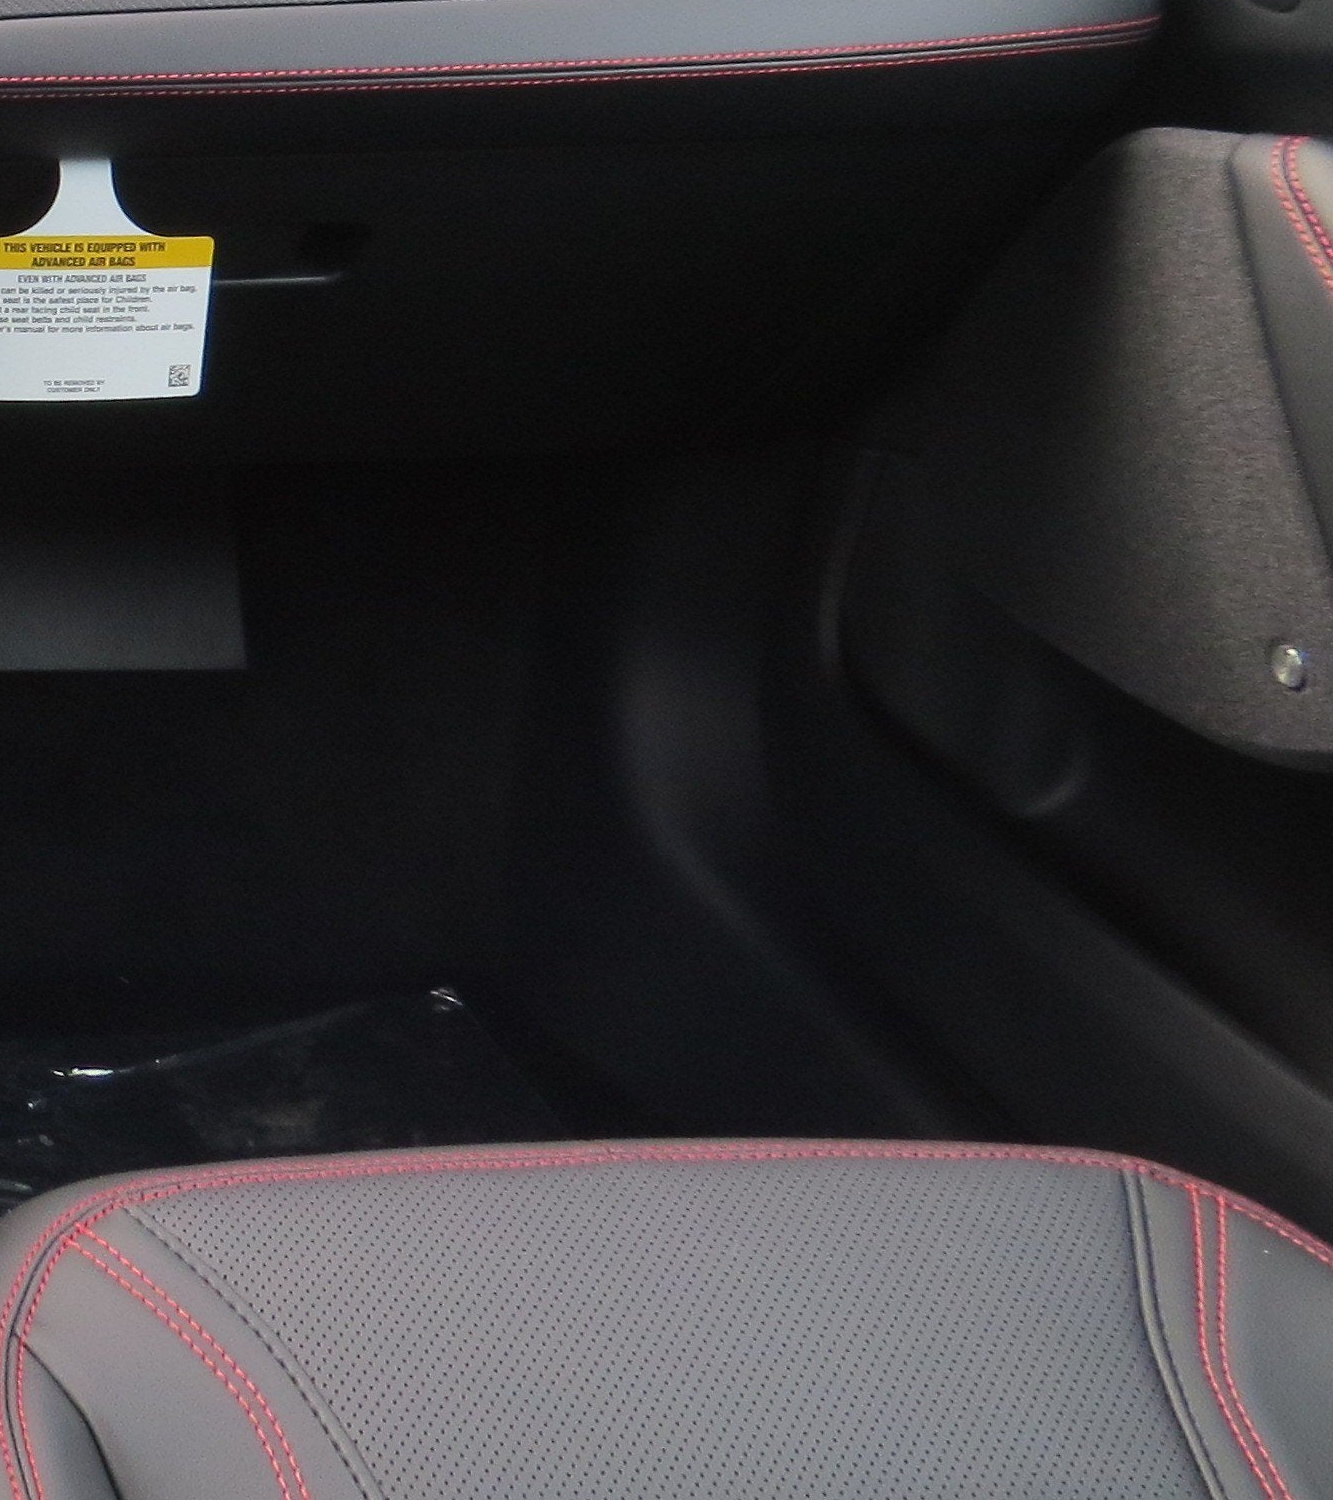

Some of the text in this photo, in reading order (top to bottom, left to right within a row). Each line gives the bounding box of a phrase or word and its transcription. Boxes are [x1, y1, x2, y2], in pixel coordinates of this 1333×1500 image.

[4, 241, 166, 253] THIS VEHICLE IS EQUIPPED WITH
[31, 256, 136, 267] ADVANCED AIR BAGS
[17, 274, 147, 283] EVEN WITH ADVANCED AIR BAGS
[0, 287, 17, 295] can
[18, 286, 29, 295] be
[31, 286, 54, 295] killed
[68, 286, 107, 296] seriously
[109, 285, 138, 295] injured
[152, 285, 165, 293] the
[2, 296, 20, 304] seat
[33, 295, 46, 304] the
[75, 296, 99, 305] place
[112, 305, 125, 313] the
[73, 315, 93, 323] child
[13, 325, 45, 333] manual
[47, 324, 59, 333] for
[135, 324, 159, 332] about
[161, 323, 171, 331] air
